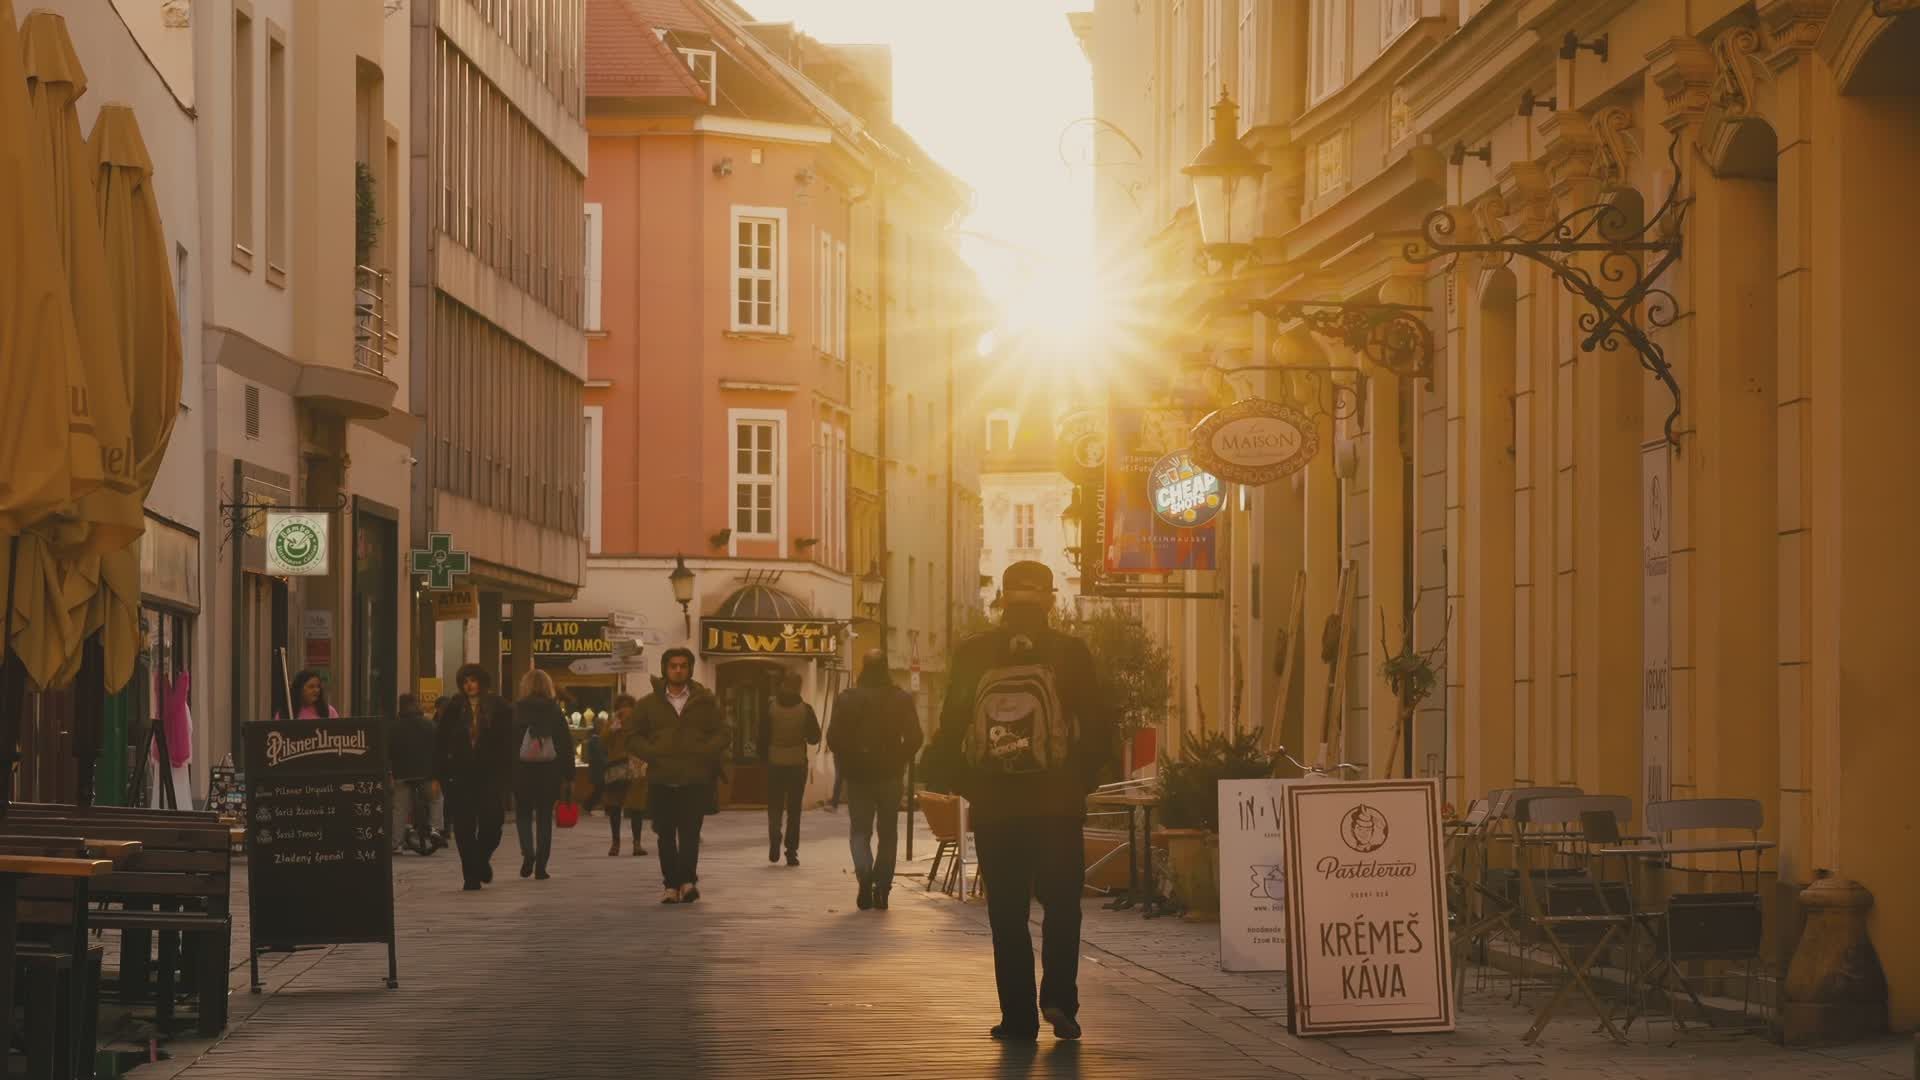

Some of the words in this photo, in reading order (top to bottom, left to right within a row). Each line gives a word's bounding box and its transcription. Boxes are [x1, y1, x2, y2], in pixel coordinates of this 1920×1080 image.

[1222, 431, 1297, 450] MAISON
[1157, 472, 1217, 508] CHEAP
[1170, 494, 1206, 514] SHOTS
[541, 622, 579, 636] ZLATO
[564, 639, 612, 652] DIAMON
[315, 728, 367, 756] Urquell
[1319, 912, 1424, 958] KRÉMEŠ
[1341, 957, 1407, 1001] KÁVA
